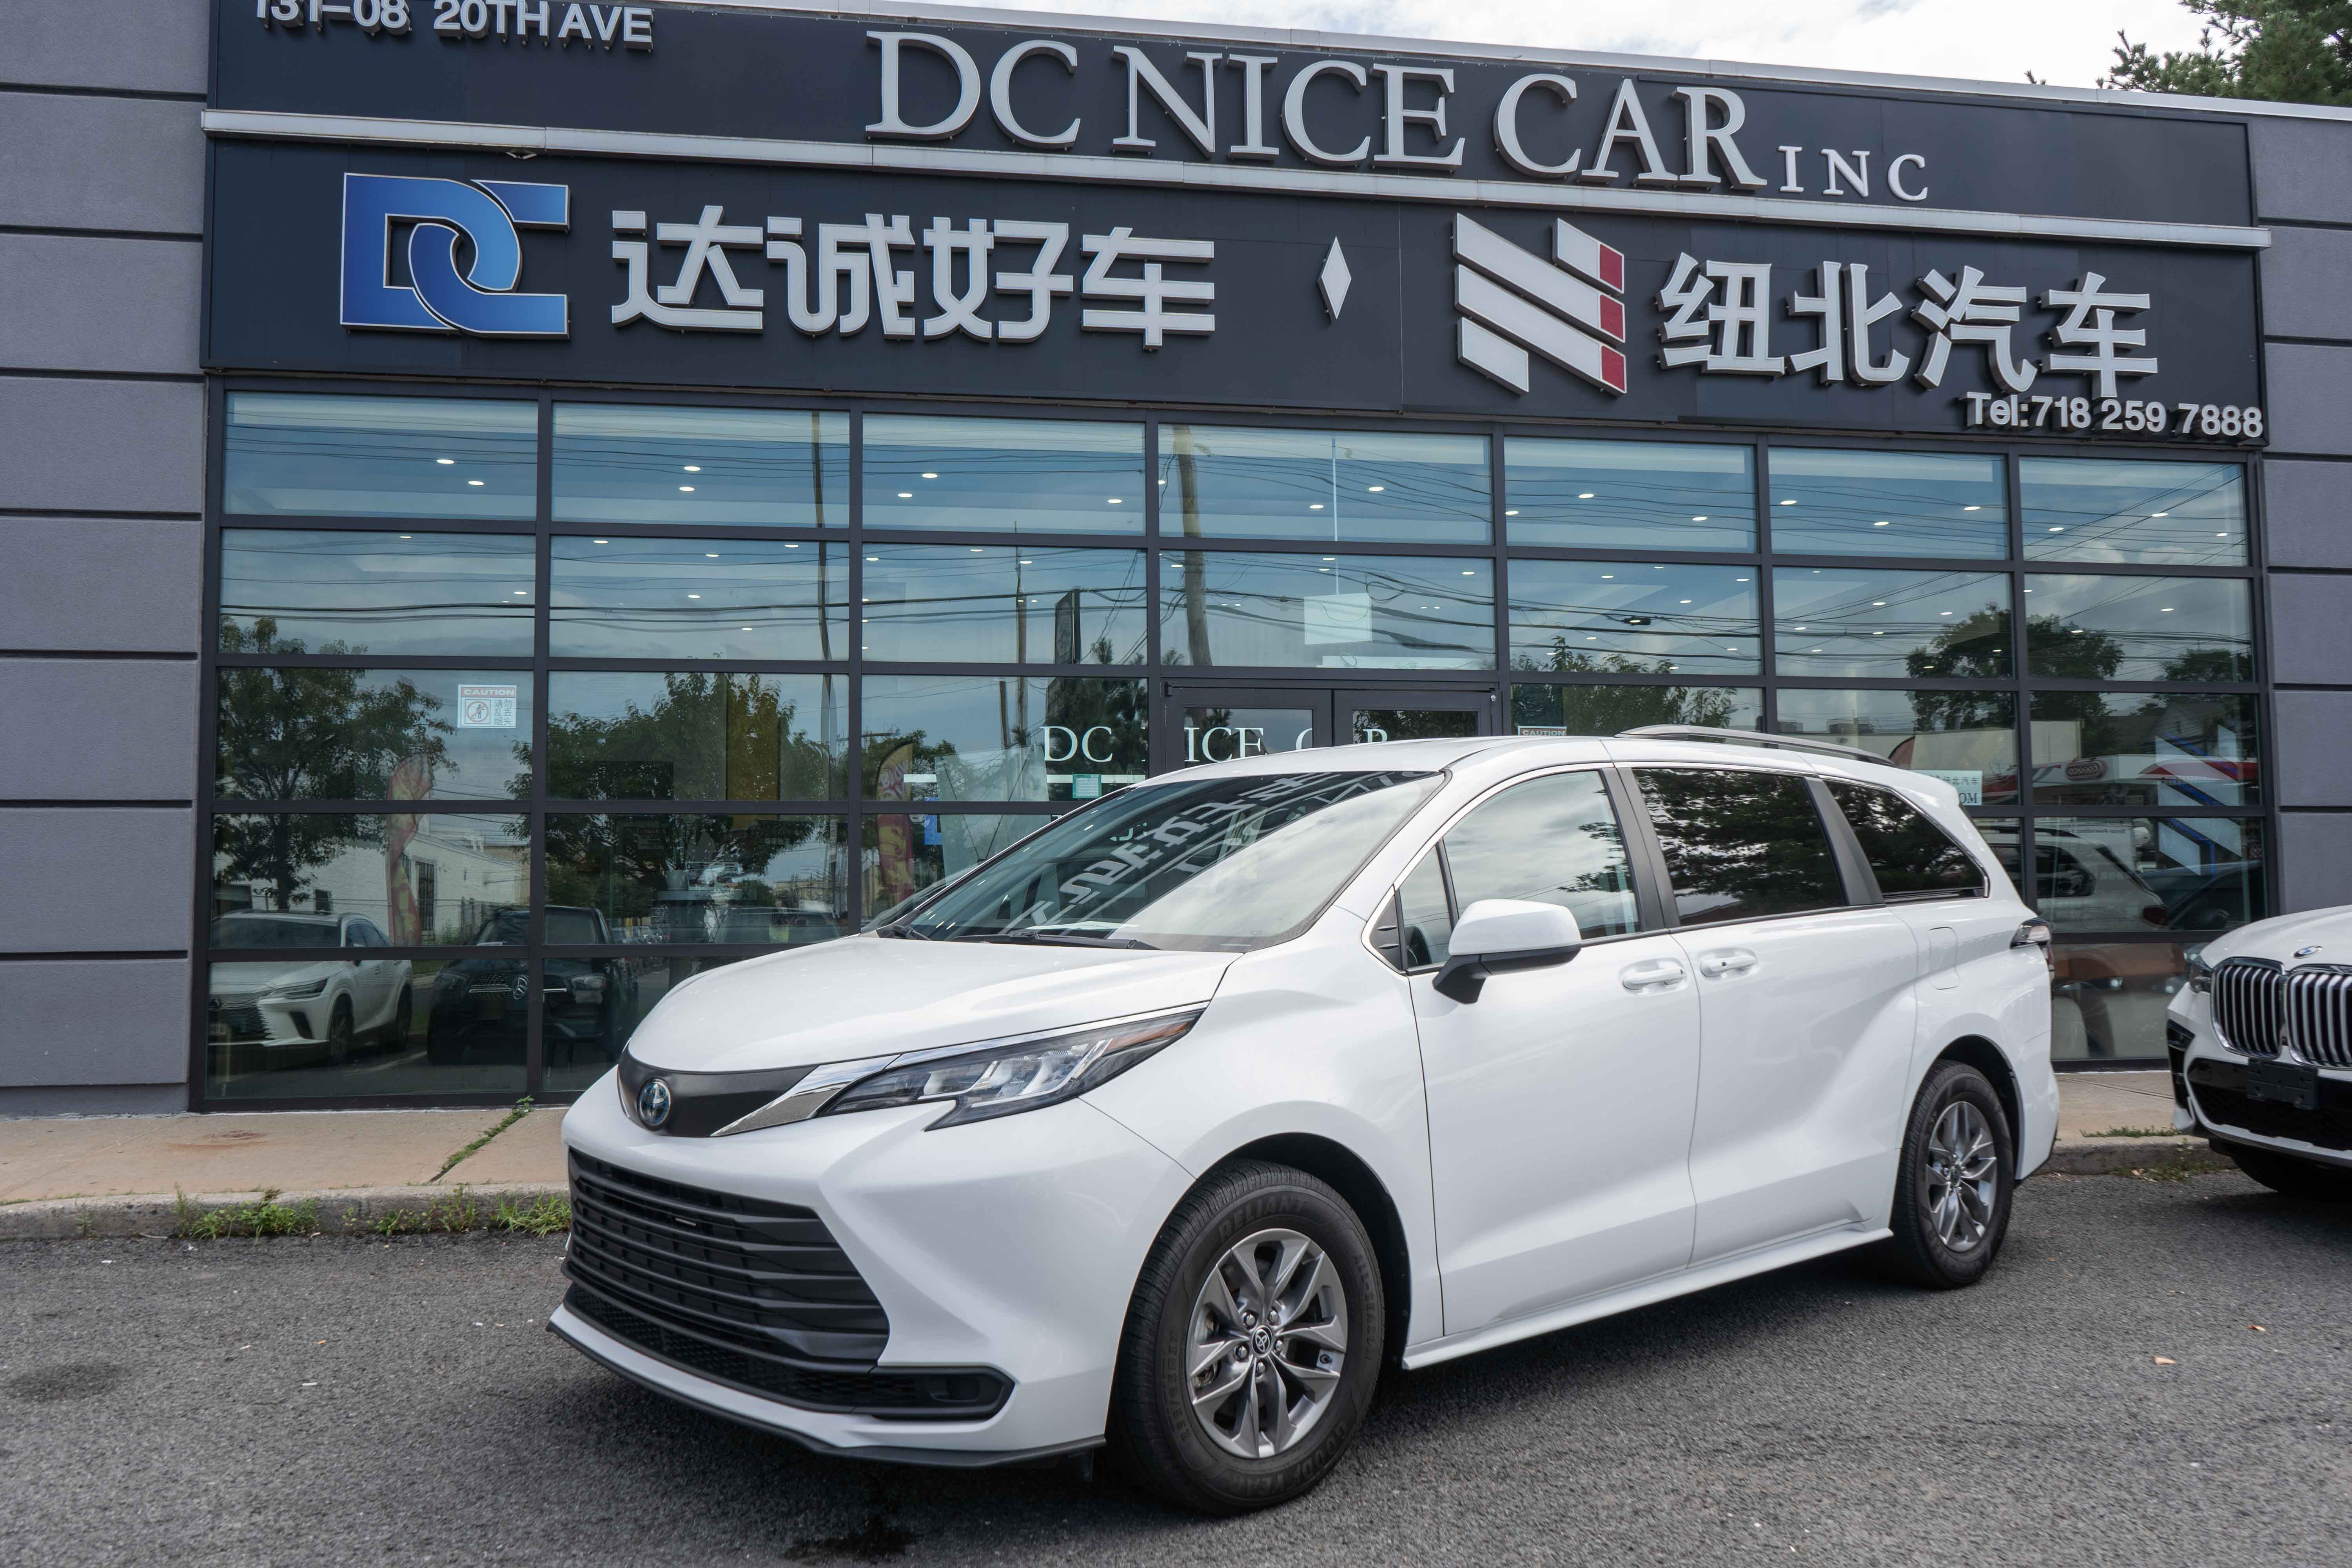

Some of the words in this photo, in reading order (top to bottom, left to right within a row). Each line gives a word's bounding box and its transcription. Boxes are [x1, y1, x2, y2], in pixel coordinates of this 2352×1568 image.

[434, 0, 548, 36] 20TH
[558, 4, 652, 42] AVE
[867, 31, 1080, 147] DC
[1112, 46, 1466, 169] NICE
[1494, 73, 1767, 185] CAR
[1779, 146, 1928, 201] INC
[612, 205, 1215, 347] 达诚好车
[1660, 252, 2158, 397] 纽北汽车
[2101, 399, 2166, 432] 259
[2178, 403, 2263, 437] 7888
[1040, 726, 1112, 762] DC
[1142, 727, 1268, 762] ICE
[1218, 1194, 1308, 1243] RELIANT
